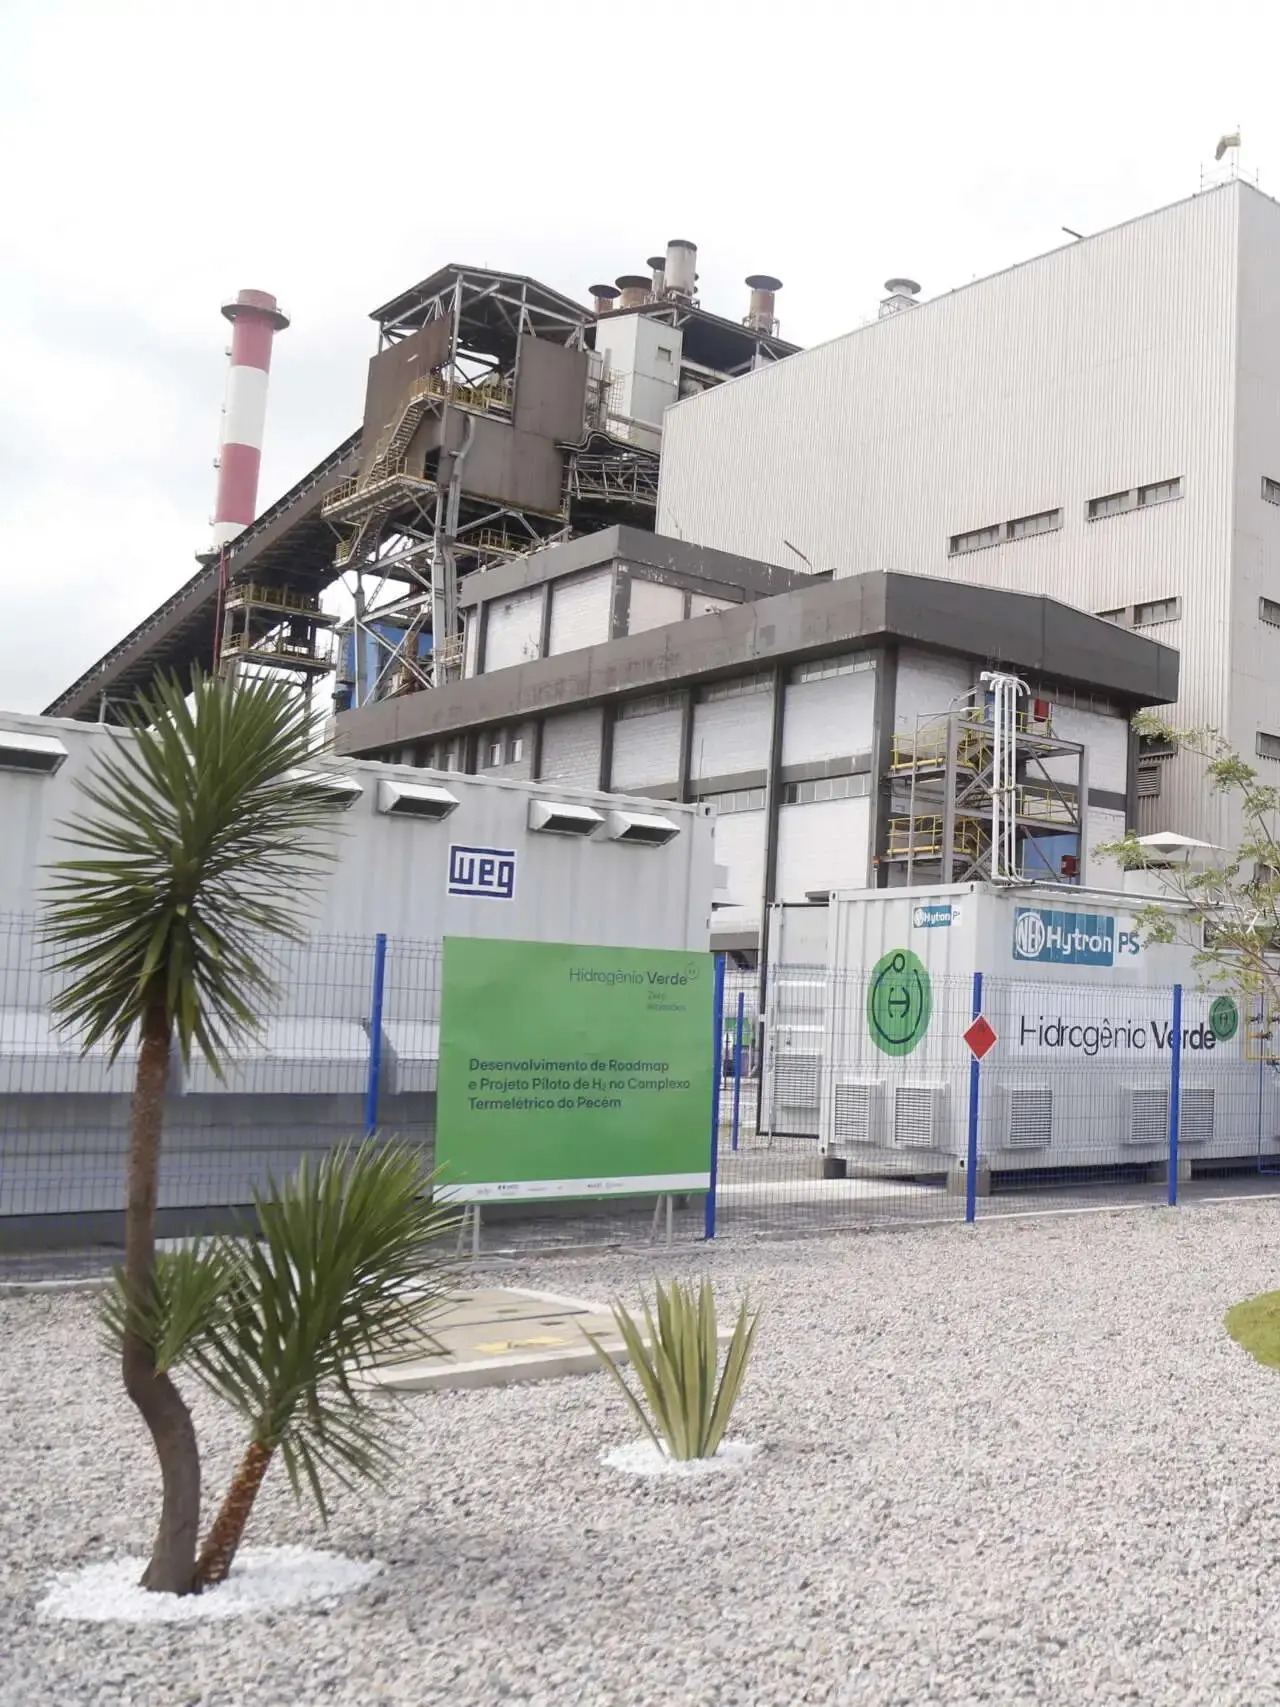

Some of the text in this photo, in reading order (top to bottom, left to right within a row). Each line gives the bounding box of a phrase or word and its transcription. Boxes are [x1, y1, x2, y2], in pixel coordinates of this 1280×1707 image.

[1047, 925, 1111, 955] Hytron
[1118, 930, 1140, 955] PS
[569, 968, 688, 985] Hidrogênio Verde
[1020, 1015, 1146, 1056] Hidrogênio
[469, 1059, 669, 1073] Desenvolvimento de Roadmap
[468, 1081, 478, 1090] e
[480, 1078, 529, 1092] Projeto
[532, 1078, 571, 1090] Piloto
[573, 1079, 590, 1090] de
[610, 1080, 625, 1090] no
[628, 1078, 690, 1091] Complexo
[557, 1098, 574, 1109] do
